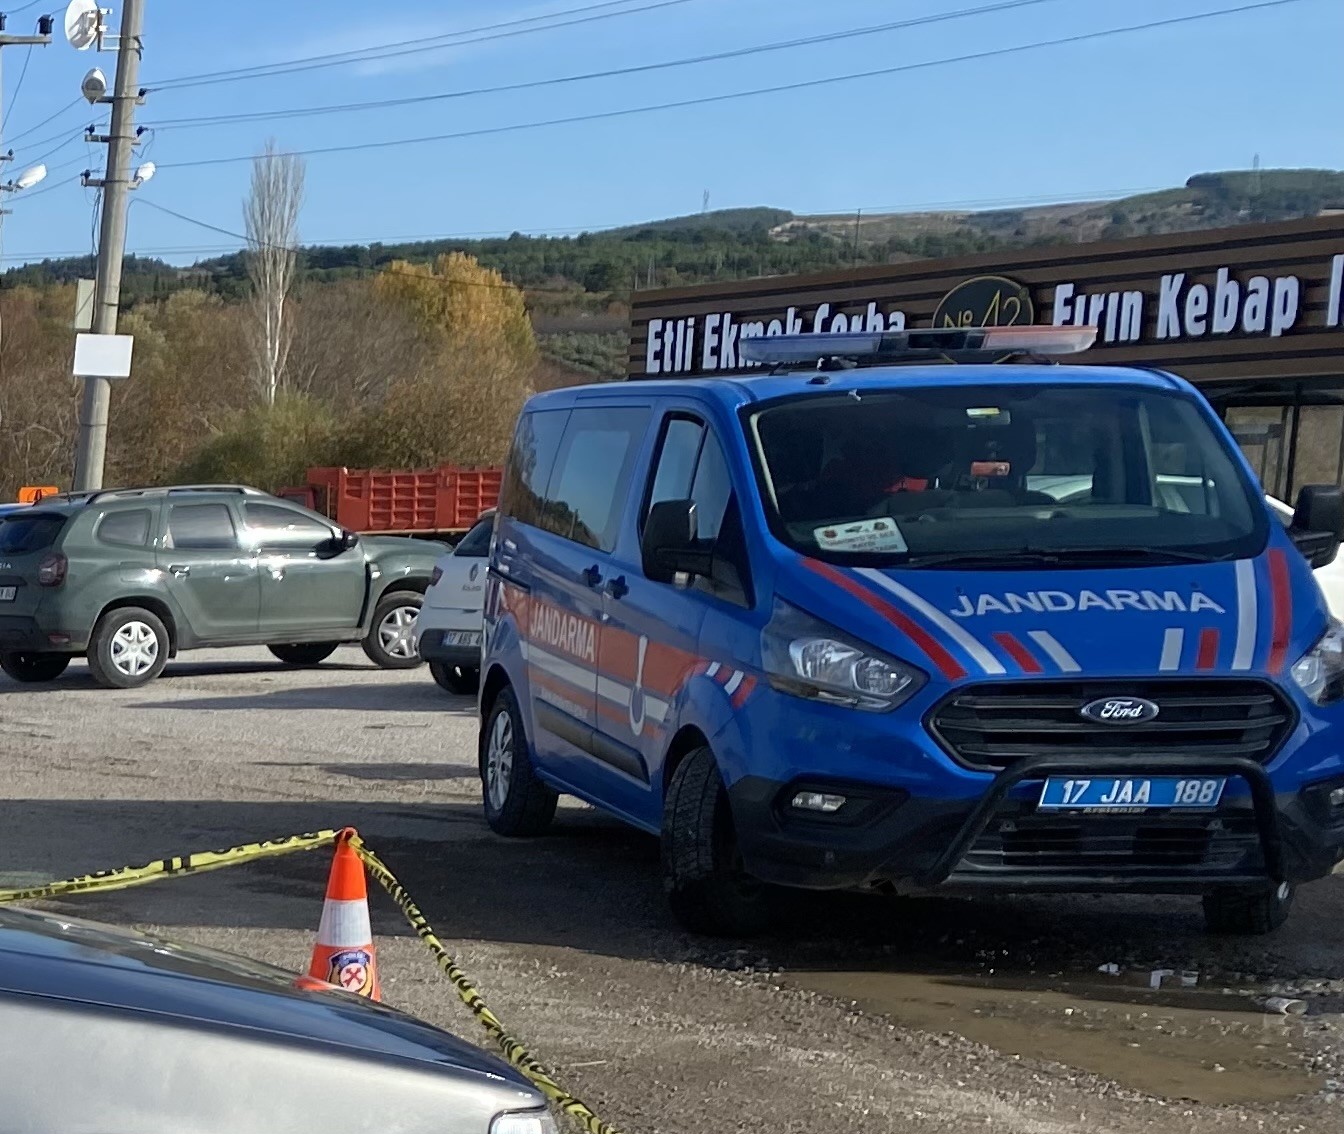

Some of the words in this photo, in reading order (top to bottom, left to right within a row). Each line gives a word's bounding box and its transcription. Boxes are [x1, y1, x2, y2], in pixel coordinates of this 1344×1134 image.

[1156, 267, 1300, 338] Kebap
[646, 316, 696, 373] Etli
[950, 589, 1226, 618] JANDARMA
[531, 602, 595, 663] JANDARMA
[1100, 700, 1144, 719] Ford
[1062, 780, 1091, 804] 17
[1100, 780, 1151, 804] JAA
[1174, 780, 1218, 804] 188
